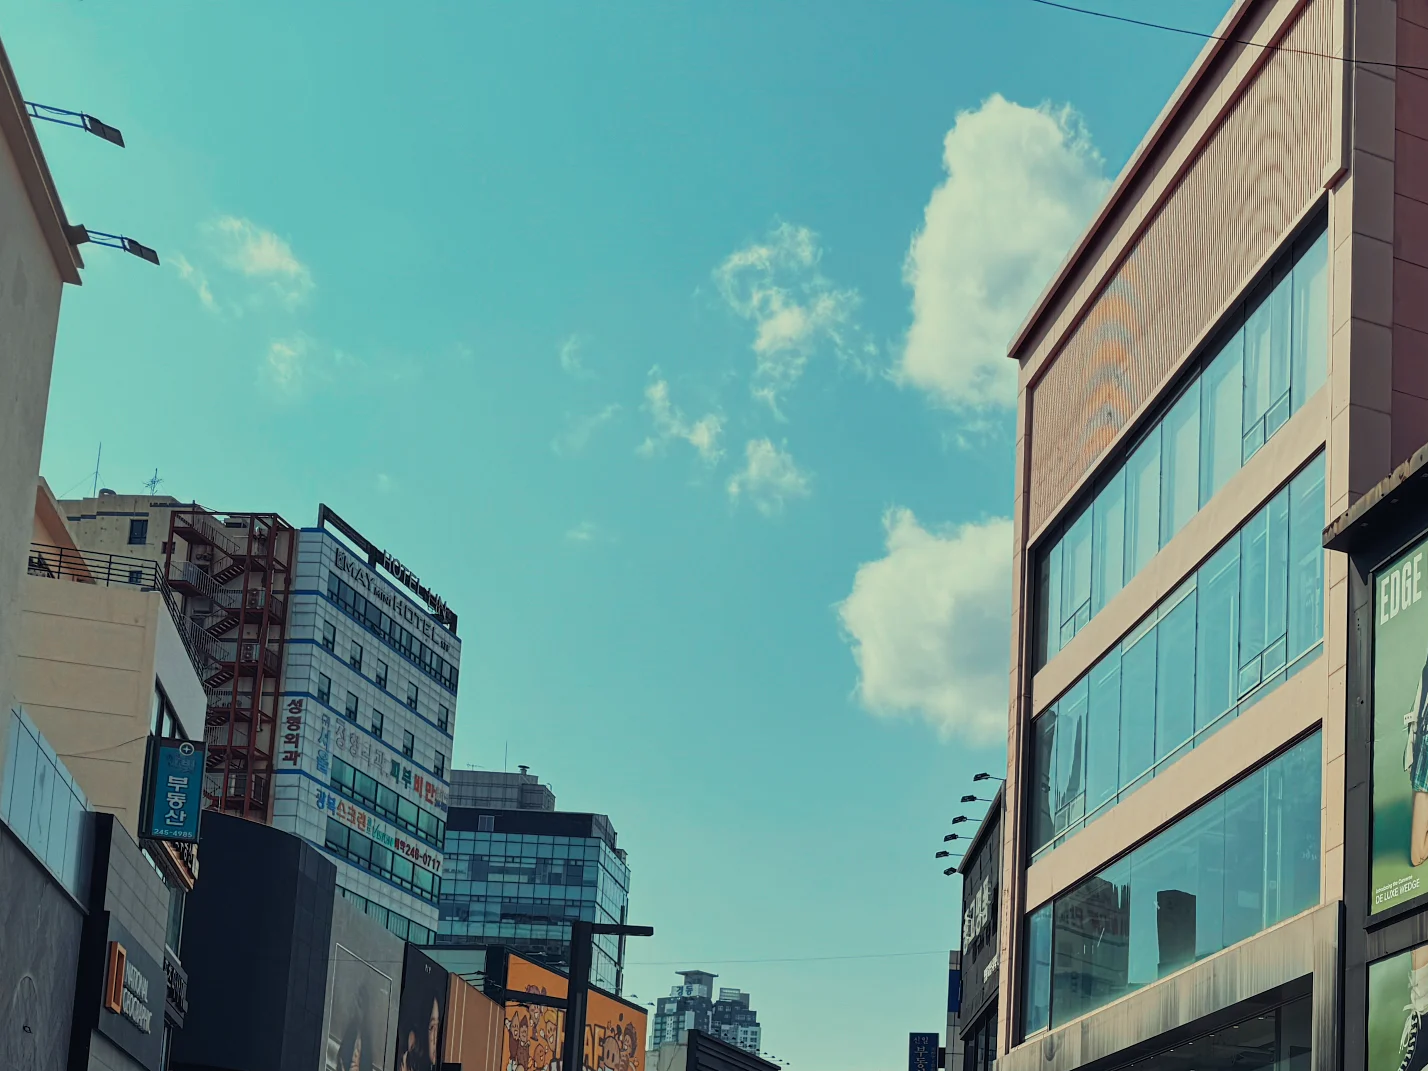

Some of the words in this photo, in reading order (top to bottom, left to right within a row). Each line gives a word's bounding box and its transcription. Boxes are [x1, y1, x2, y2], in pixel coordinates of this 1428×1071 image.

[1379, 552, 1423, 625] EDGE
[392, 595, 439, 646] HOTEL
[164, 775, 189, 827] 부동산
[153, 828, 193, 838] 245-4985
[1375, 894, 1384, 905] DE
[1383, 886, 1399, 902] LUXE
[1399, 878, 1421, 895] WEDGE
